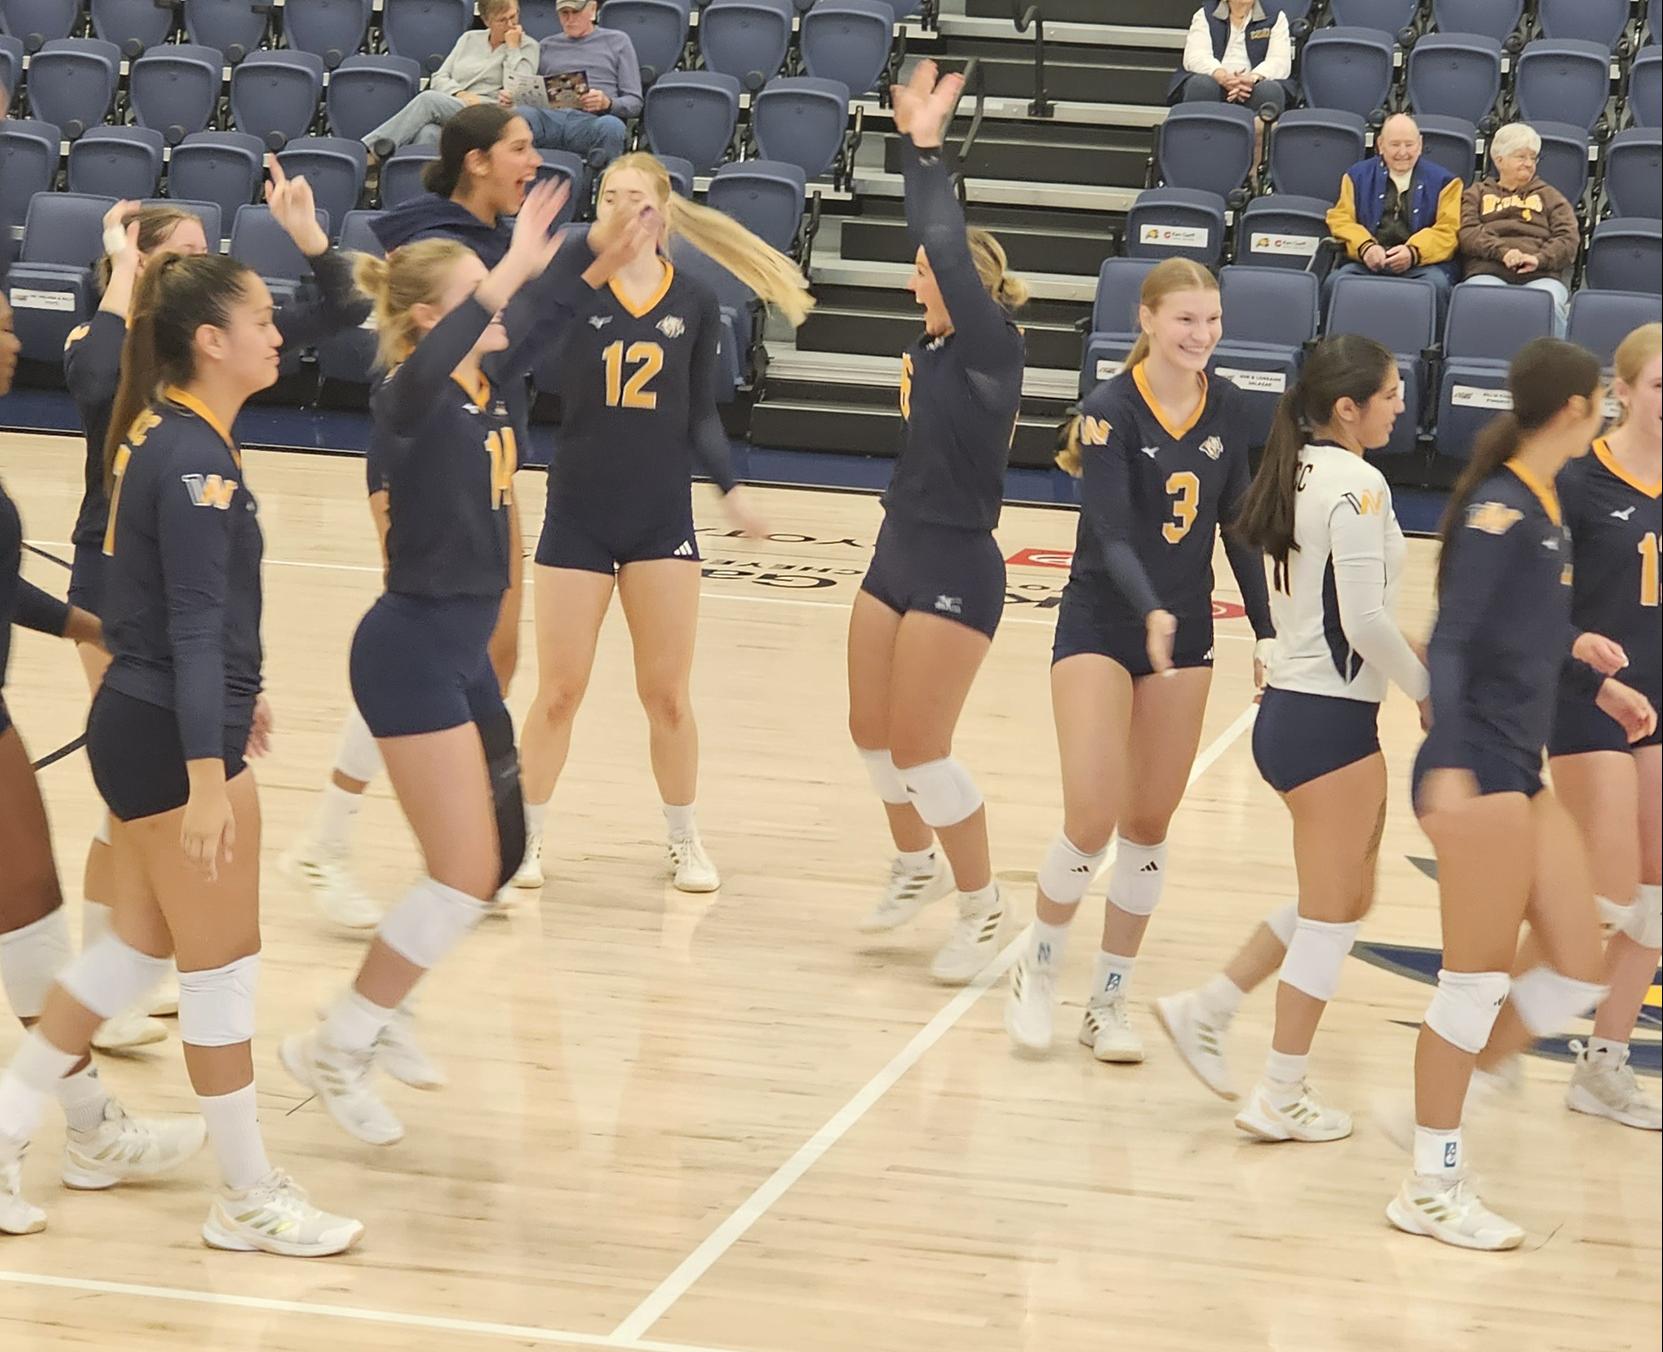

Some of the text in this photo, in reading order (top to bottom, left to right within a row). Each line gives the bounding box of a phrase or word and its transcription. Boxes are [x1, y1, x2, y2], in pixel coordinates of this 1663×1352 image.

[601, 340, 664, 409] 12
[1162, 471, 1200, 544] 3
[699, 558, 865, 576] CHEYE
[1637, 532, 1662, 607] 1
